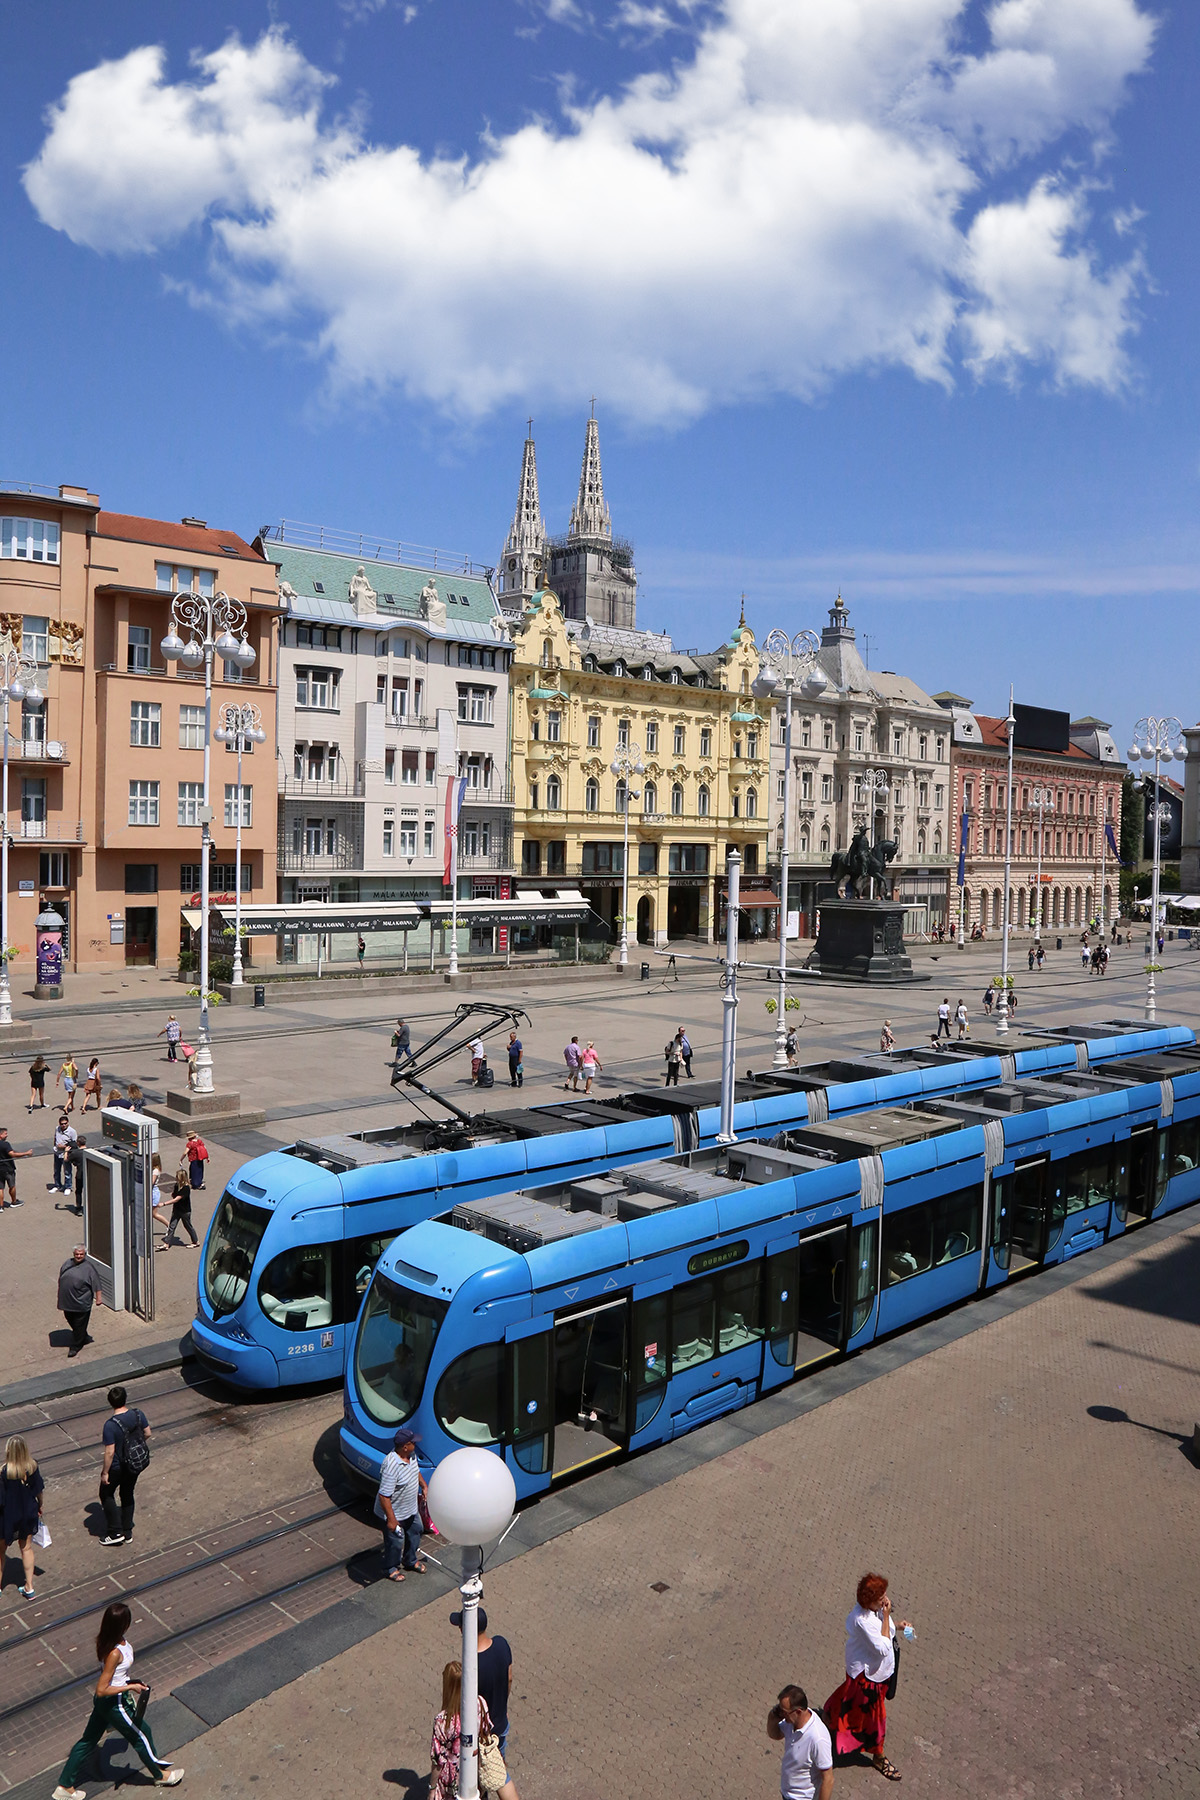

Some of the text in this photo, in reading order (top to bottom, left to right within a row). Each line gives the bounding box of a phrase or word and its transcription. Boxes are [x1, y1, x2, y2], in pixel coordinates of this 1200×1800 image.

[400, 890, 430, 898] KAVANA
[703, 1250, 738, 1267] DUBRAVA
[288, 1343, 315, 1355] 2236
